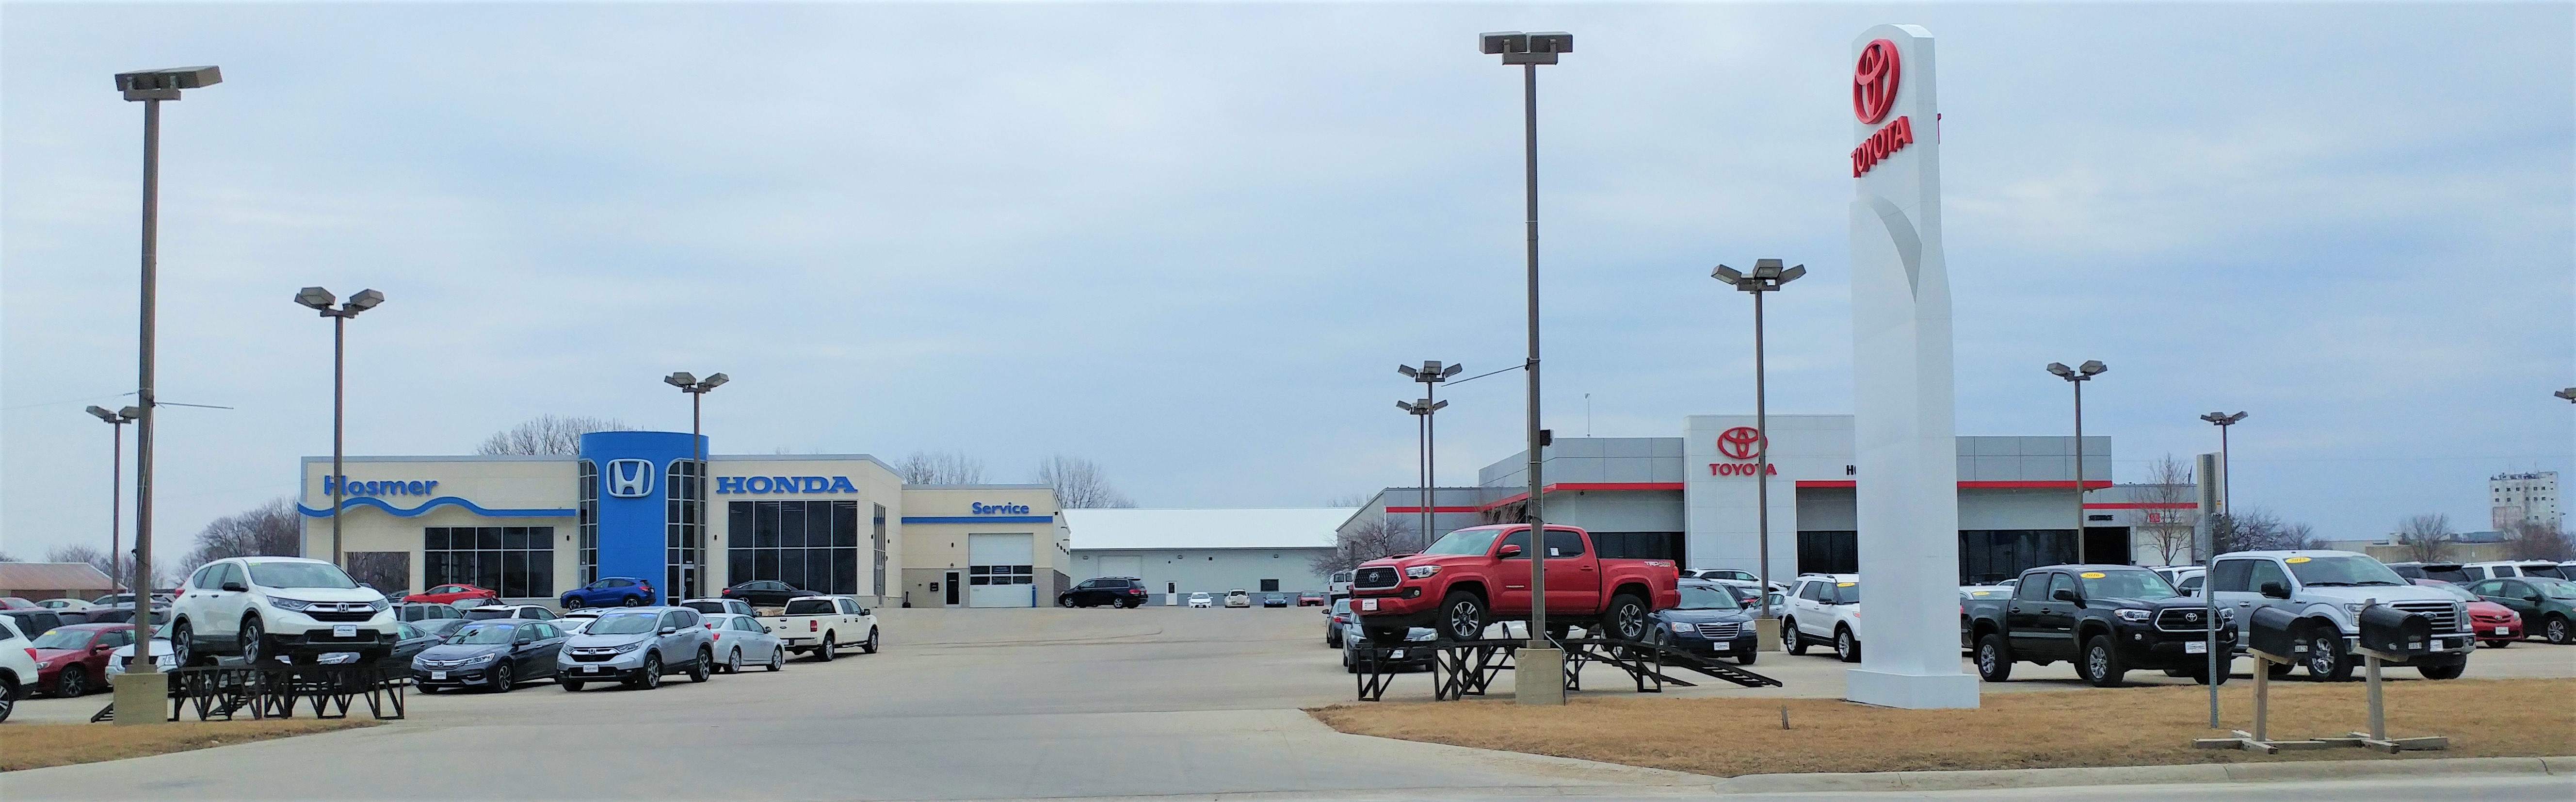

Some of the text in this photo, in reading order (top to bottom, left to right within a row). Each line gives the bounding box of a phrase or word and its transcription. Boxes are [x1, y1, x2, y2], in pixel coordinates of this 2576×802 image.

[1851, 116, 1913, 178] TOYOTA
[324, 475, 439, 495] Hosmer
[716, 476, 858, 494] HONDA
[972, 502, 1030, 514] Service
